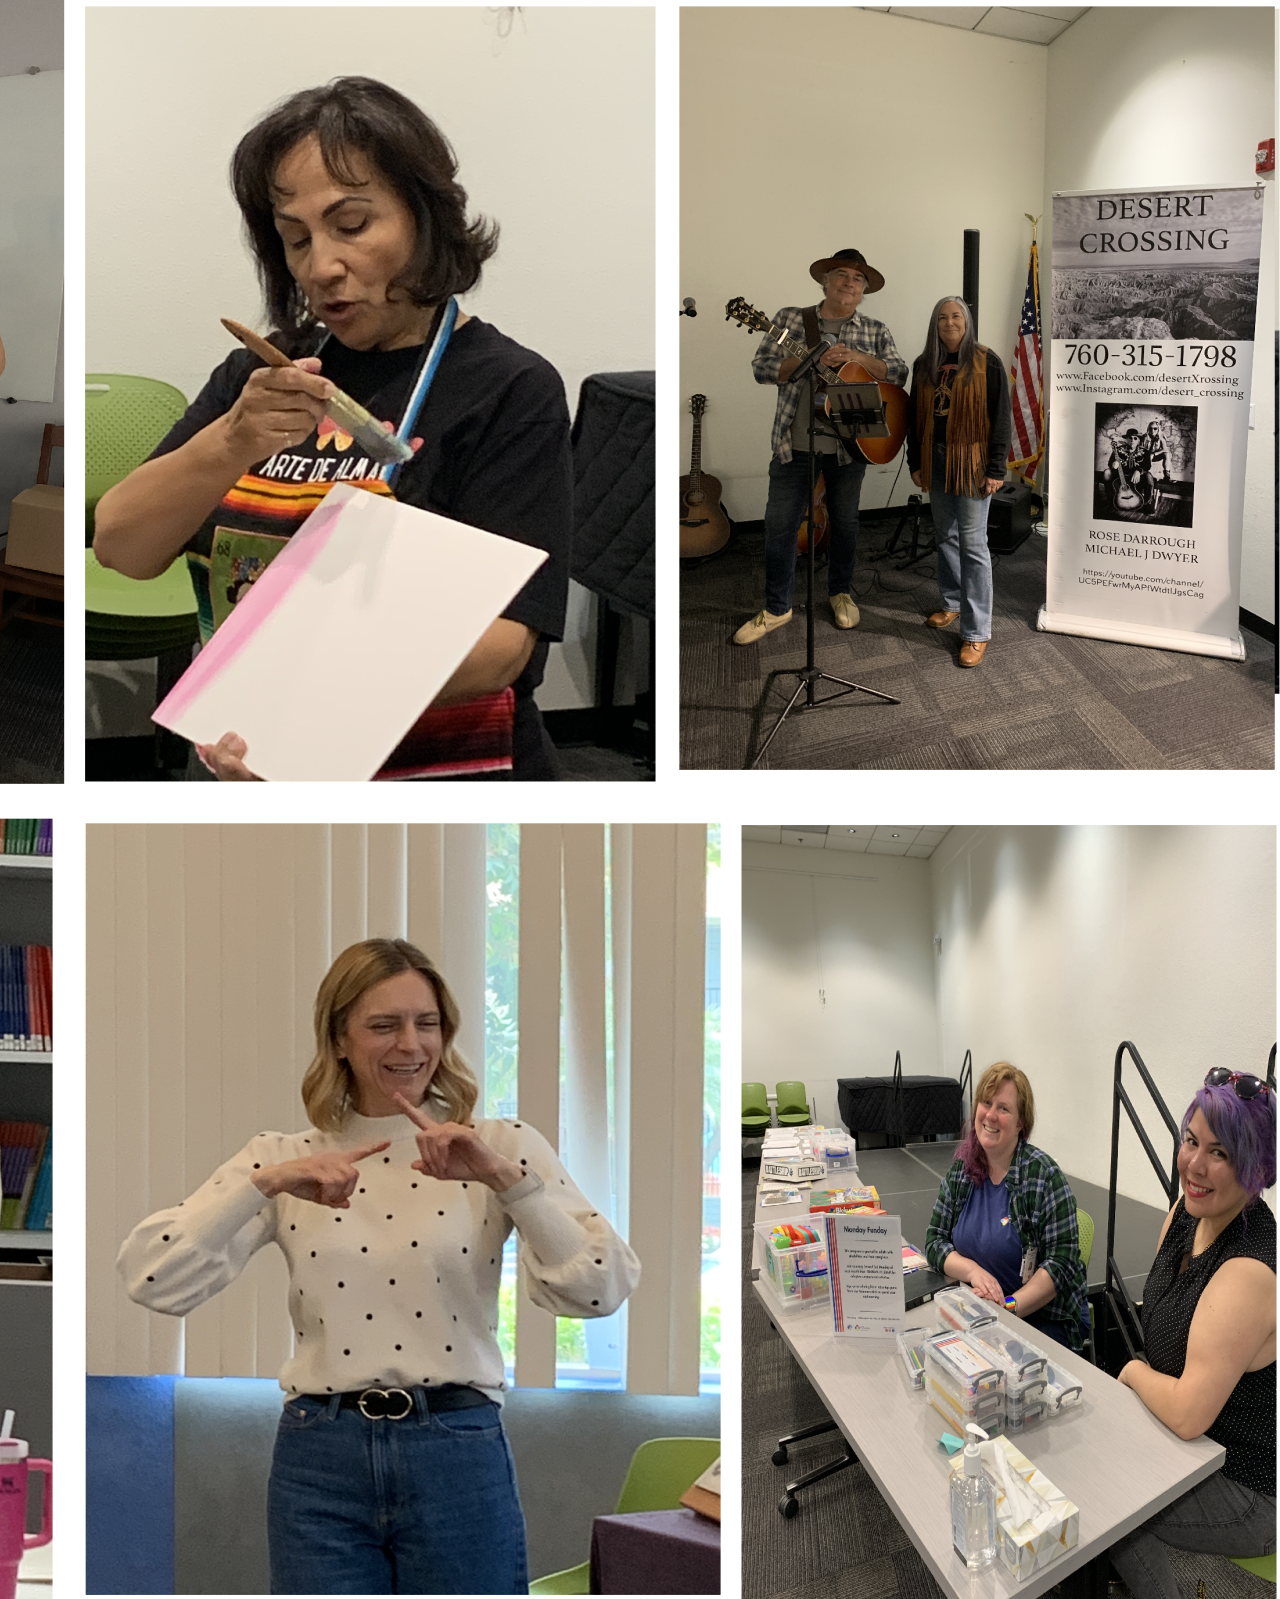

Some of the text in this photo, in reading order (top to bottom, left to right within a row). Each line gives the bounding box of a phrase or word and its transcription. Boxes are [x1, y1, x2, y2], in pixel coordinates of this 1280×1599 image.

[1096, 194, 1214, 221] DESERT
[1079, 228, 1230, 254] CROSSING
[1064, 343, 1238, 369] 760-315-1798
[1055, 371, 1240, 387] www.Facebook.com/desertXrossing
[1055, 384, 1245, 400] www.Instagram.com/desert_crossing
[258, 453, 314, 482] ARTE
[306, 457, 337, 483] DE
[1089, 530, 1196, 549] ROSE DARROUGH
[1085, 543, 1199, 564] MICHAEL J DWYER
[1082, 568, 1204, 588] https://youtube.com/channel/
[843, 1225, 888, 1236] Monday Funday
